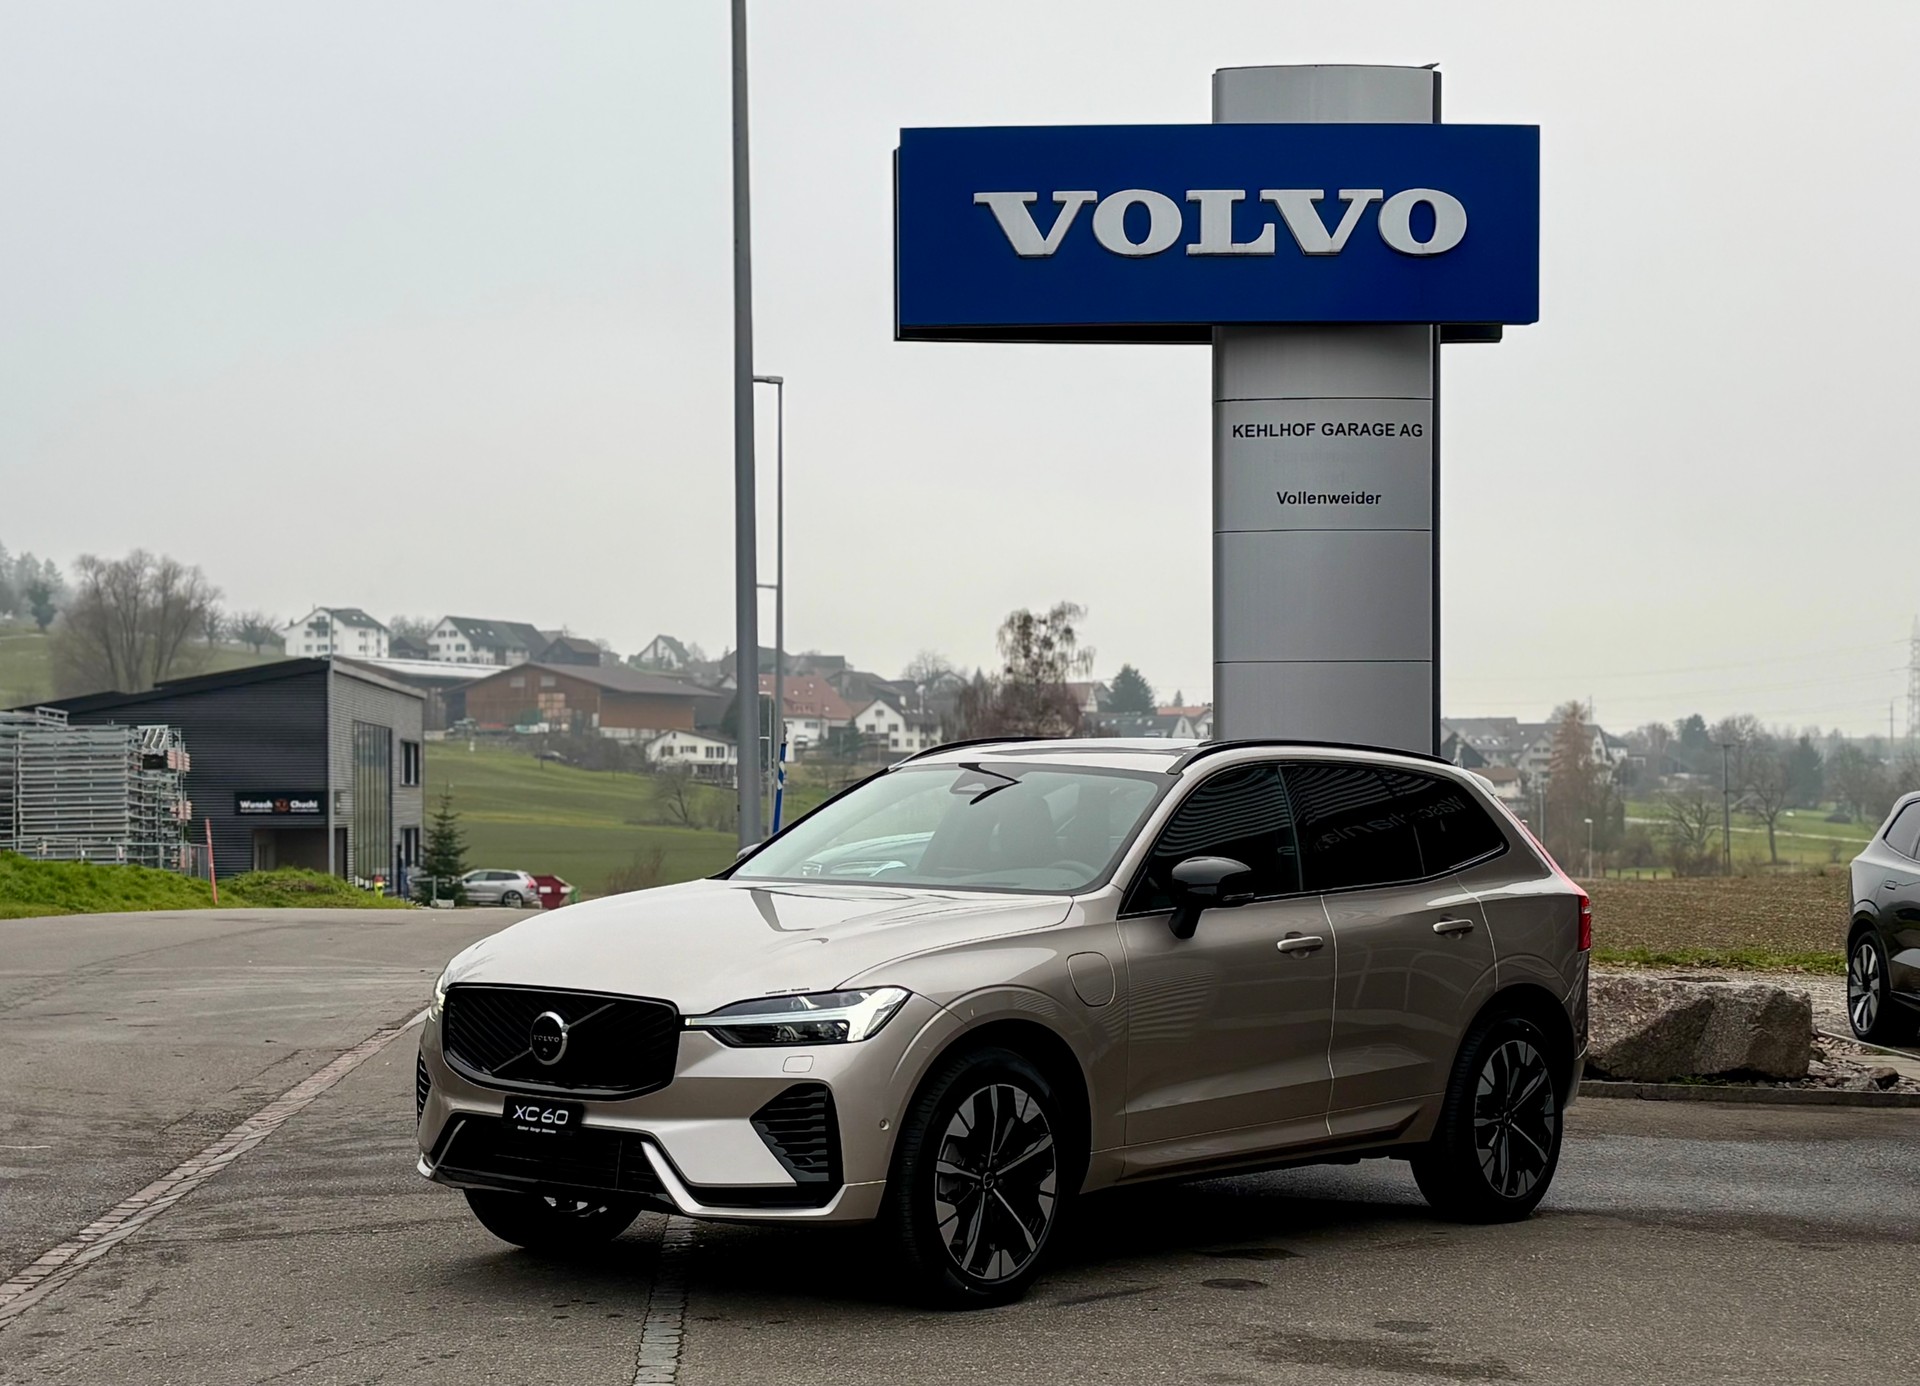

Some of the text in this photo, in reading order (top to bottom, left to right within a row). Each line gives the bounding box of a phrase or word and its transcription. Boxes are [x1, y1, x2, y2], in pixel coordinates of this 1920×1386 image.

[973, 188, 1468, 258] VOLVO
[1232, 422, 1423, 438] KEHLHOF GARAGE AG
[1276, 491, 1382, 505] Vollenweider
[512, 1104, 569, 1125] XC60
